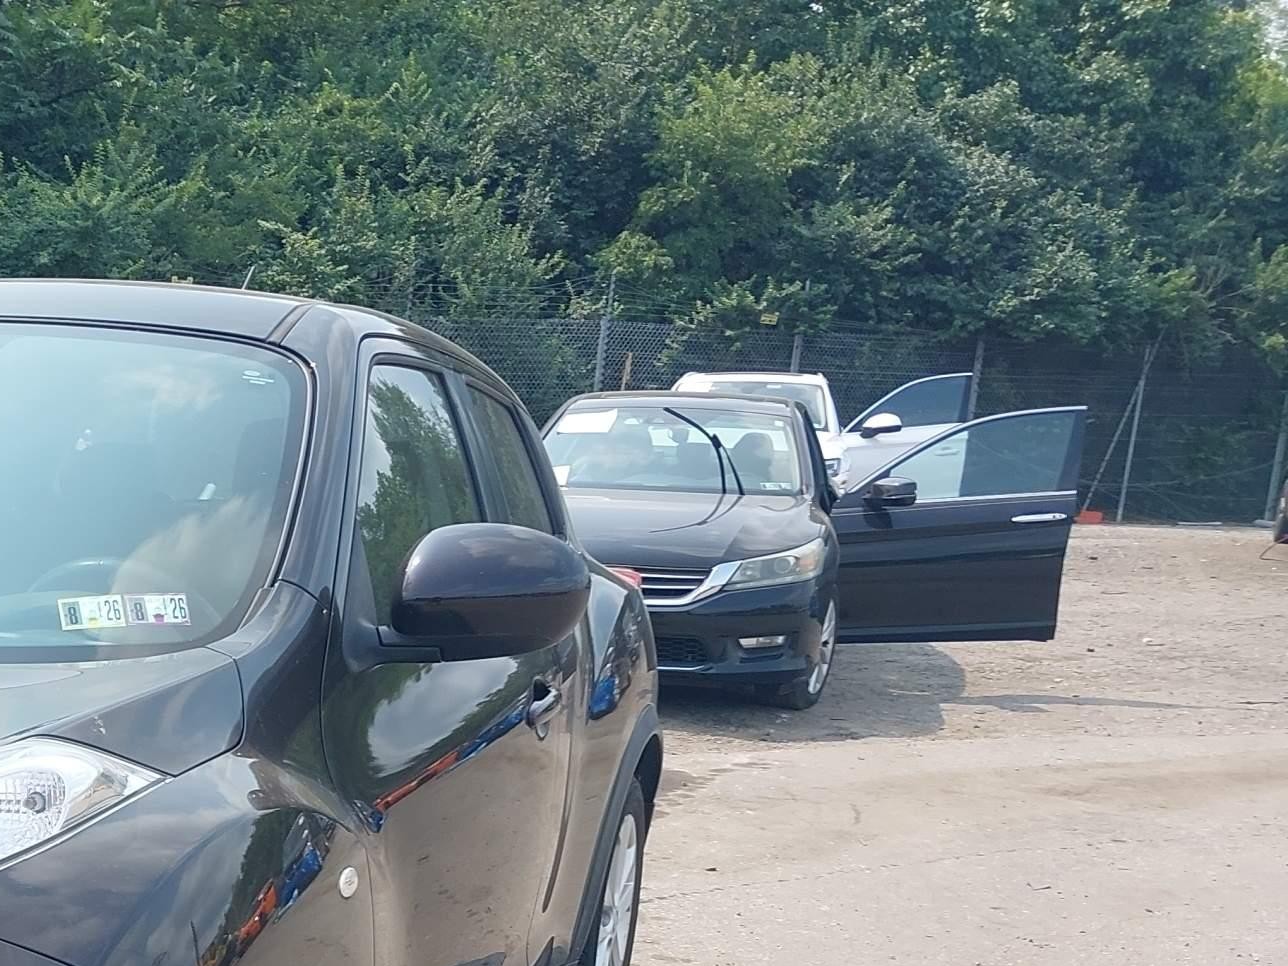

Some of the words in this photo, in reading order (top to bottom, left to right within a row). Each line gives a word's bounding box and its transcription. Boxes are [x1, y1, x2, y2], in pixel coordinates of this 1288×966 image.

[67, 606, 79, 625] 8
[104, 599, 121, 620] 26
[134, 602, 145, 621] 8
[170, 597, 187, 619] 26
